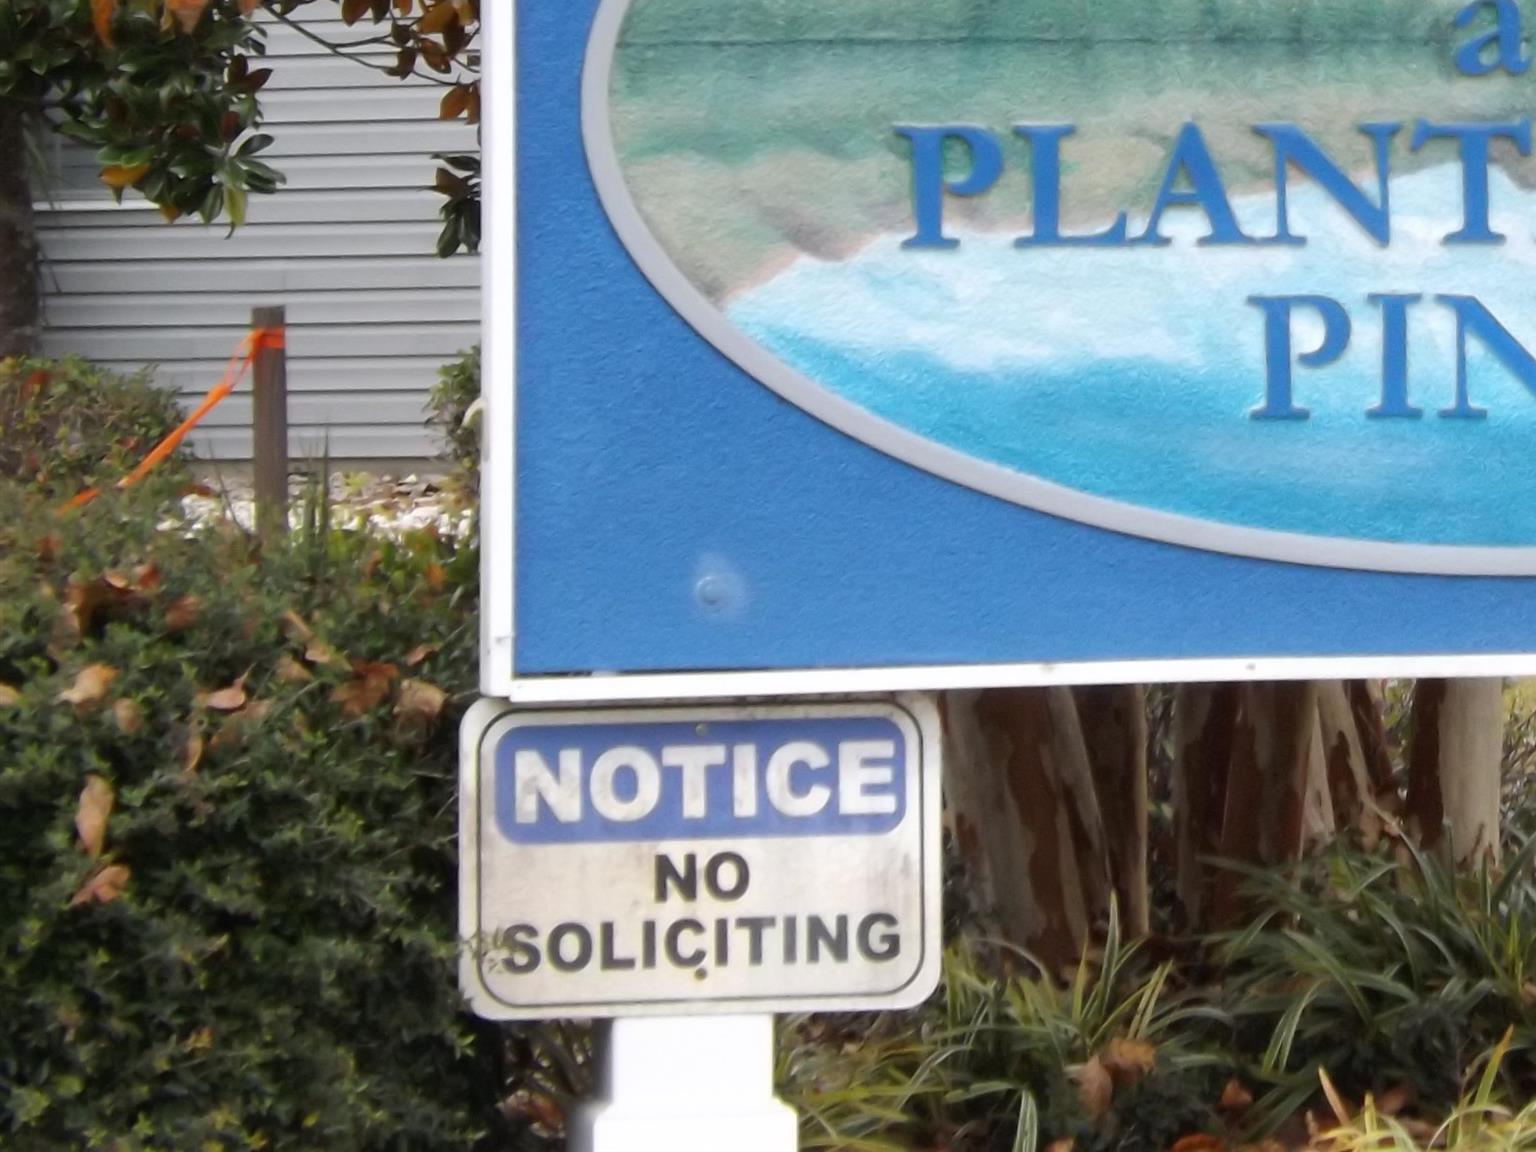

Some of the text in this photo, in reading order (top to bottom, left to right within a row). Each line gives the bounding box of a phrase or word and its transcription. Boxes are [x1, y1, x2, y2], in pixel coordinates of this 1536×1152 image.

[514, 740, 897, 824] NOTICE
[654, 851, 750, 903] NO
[501, 912, 901, 974] SOLICITING
